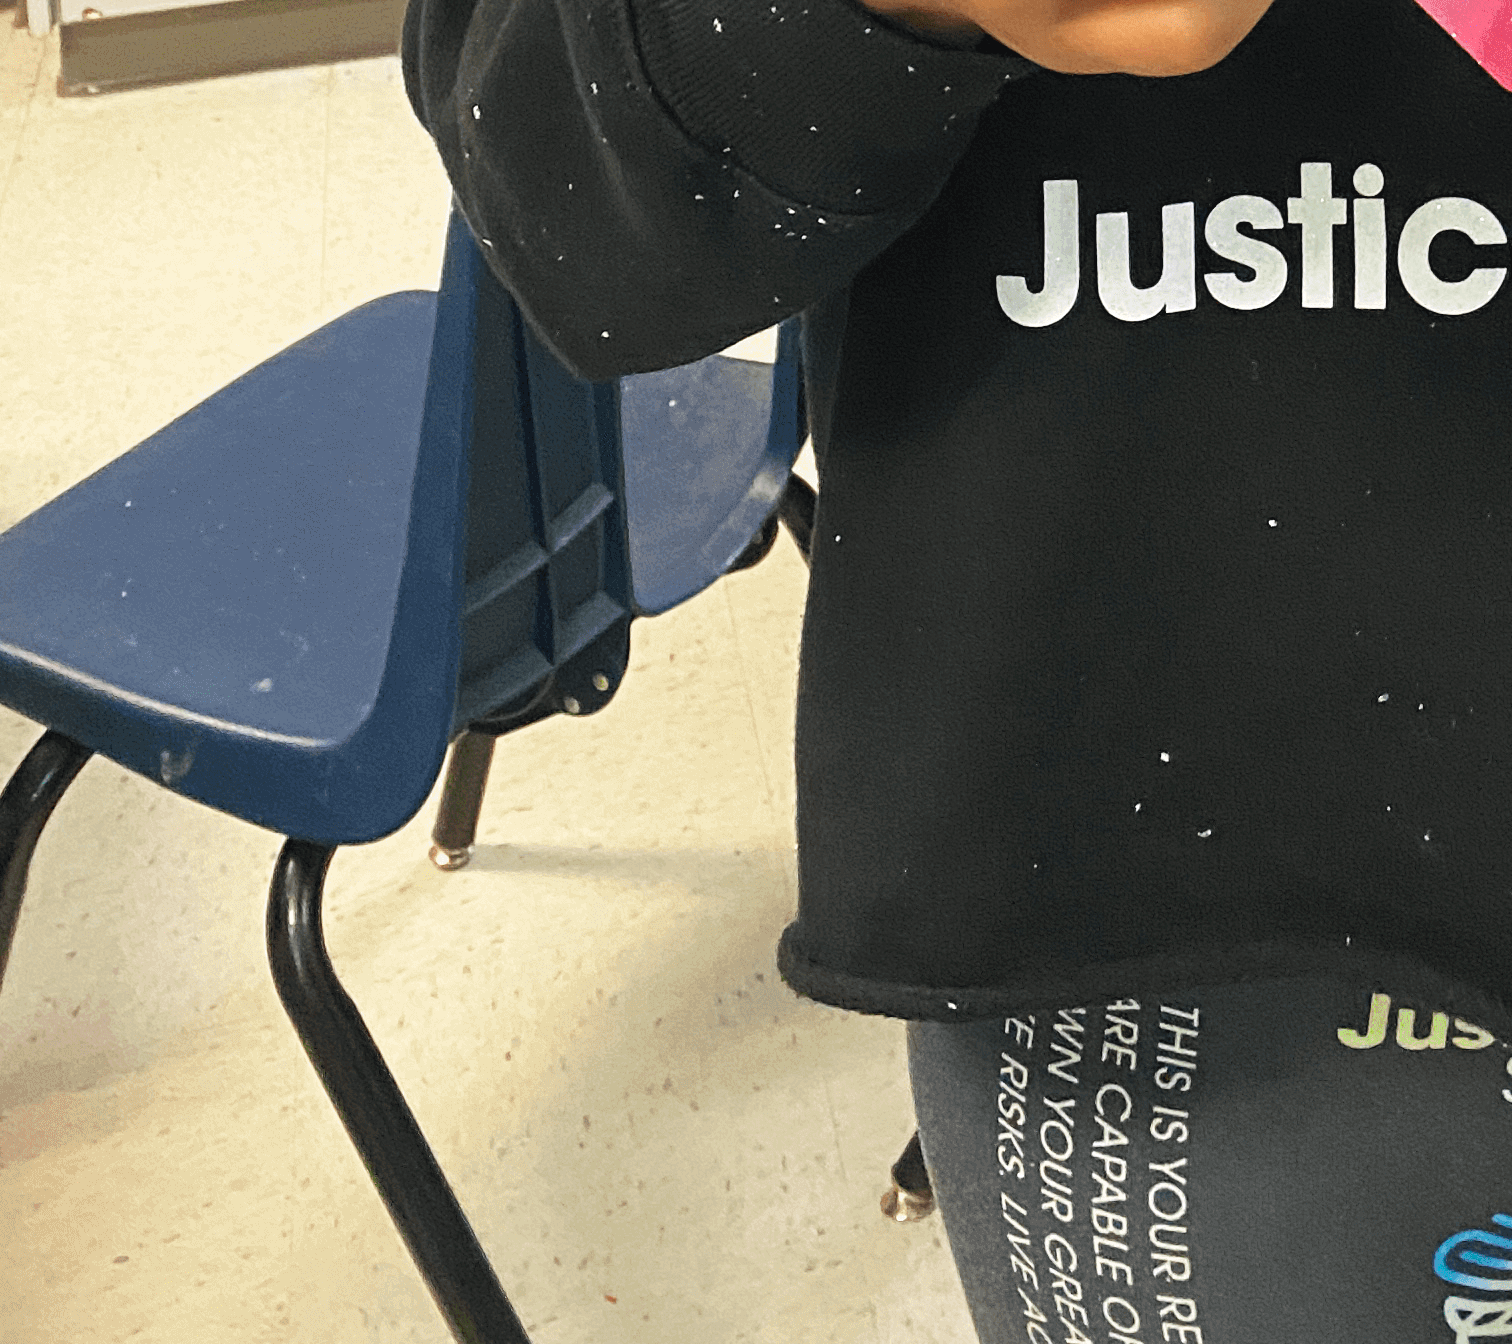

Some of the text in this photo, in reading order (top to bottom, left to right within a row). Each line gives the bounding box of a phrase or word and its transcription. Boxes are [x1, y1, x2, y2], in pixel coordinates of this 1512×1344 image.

[1154, 1005, 1199, 1092] THIS
[997, 1052, 1029, 1180] RISKS.
[1040, 1096, 1074, 1223] YOUR
[1150, 1106, 1189, 1143] IS
[1001, 1192, 1039, 1291] LIVE
[1091, 1083, 1134, 1286] CAPABLE
[1148, 1158, 1192, 1282] YOUR
